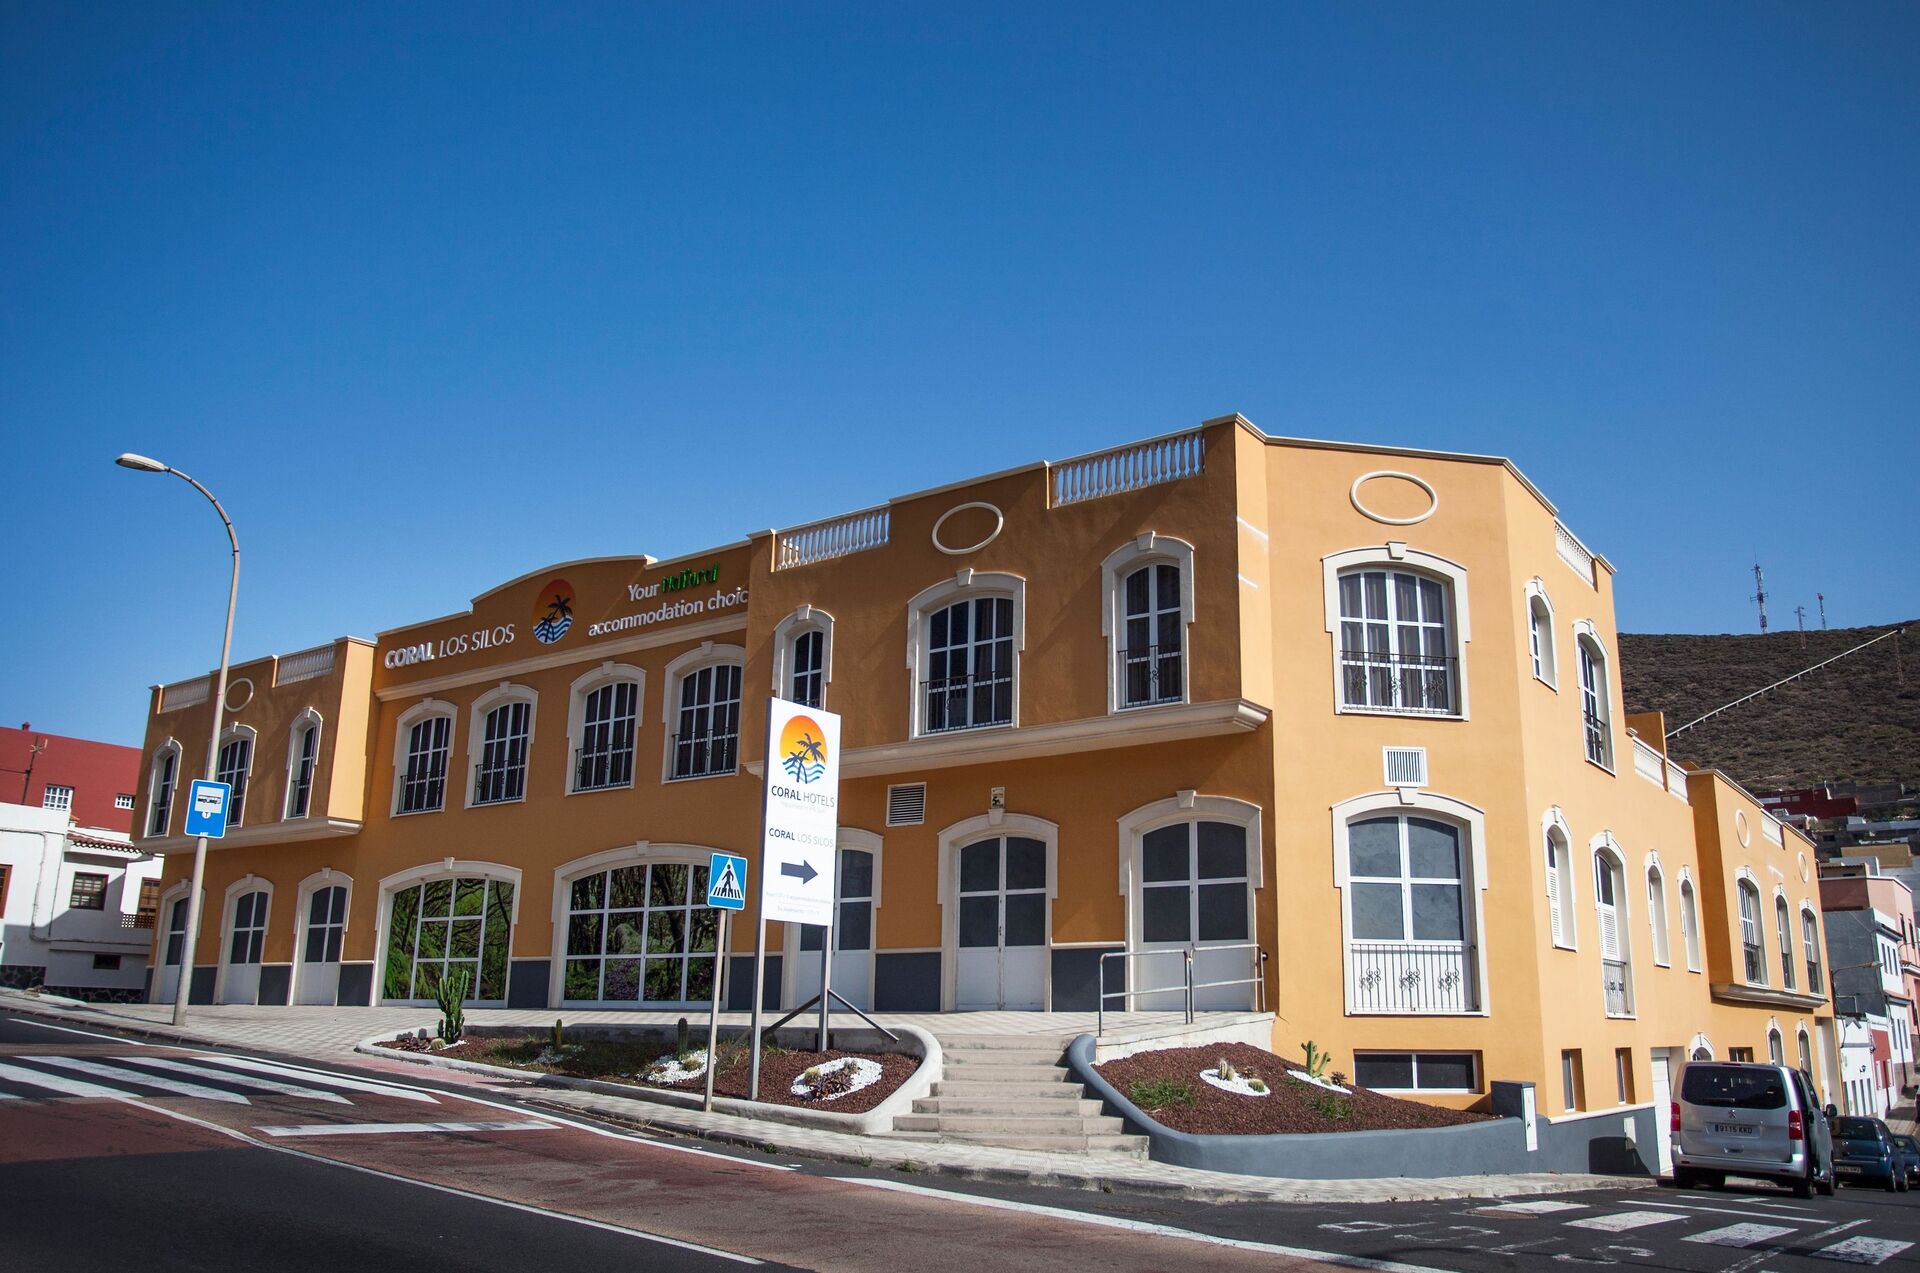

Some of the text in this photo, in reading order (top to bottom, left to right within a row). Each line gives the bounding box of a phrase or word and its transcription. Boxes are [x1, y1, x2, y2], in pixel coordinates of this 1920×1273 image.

[628, 583, 660, 602] Your
[588, 586, 749, 637] accommodation choic
[384, 623, 515, 669] CORAL LOS SILOS
[771, 785, 802, 801] CORAL
[803, 792, 835, 808] HOTELS
[769, 827, 834, 848] CORAL LOS SILOS
